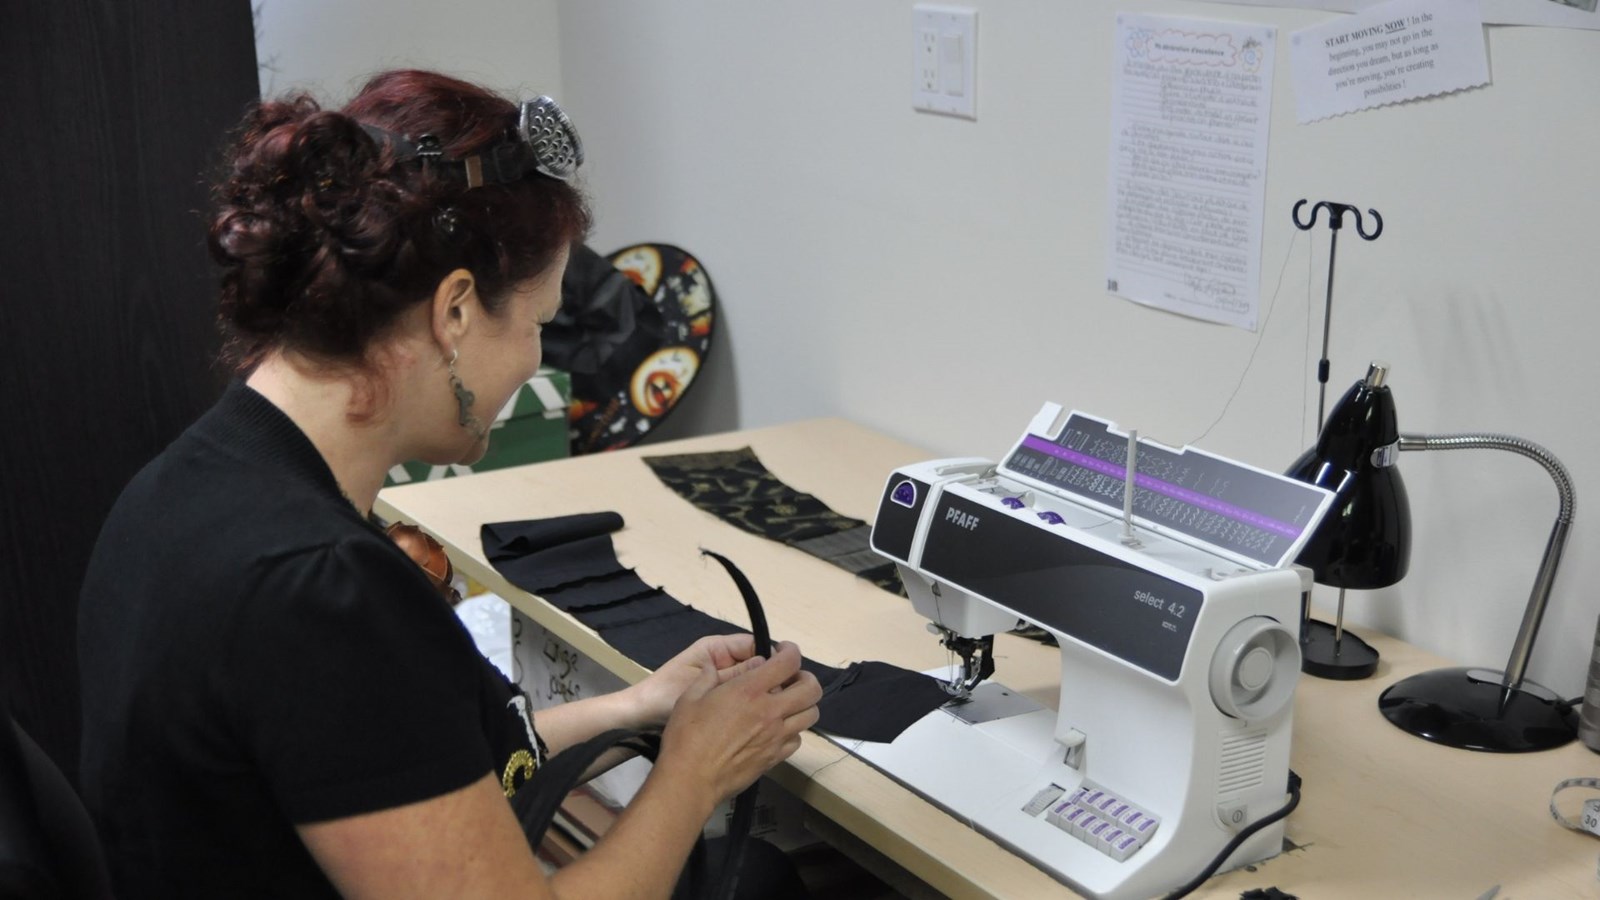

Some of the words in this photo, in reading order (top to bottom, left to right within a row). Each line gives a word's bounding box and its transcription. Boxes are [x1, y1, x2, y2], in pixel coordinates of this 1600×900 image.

[1325, 33, 1349, 47] START
[1351, 25, 1383, 40] MOVING
[1385, 20, 1406, 34] NOW
[1421, 13, 1433, 23] the
[1362, 44, 1374, 55] you
[1375, 41, 1388, 51] may
[1389, 36, 1401, 46] not
[1421, 28, 1432, 38] the
[1328, 63, 1354, 76] direction
[1356, 61, 1368, 72] you
[1369, 54, 1390, 66] dream,
[1392, 51, 1403, 61] but
[1413, 45, 1429, 56] long
[1357, 70, 1383, 83] moving,
[1406, 60, 1434, 73] creating
[1364, 82, 1402, 98] possibilities
[945, 507, 980, 531] PFAFF
[1133, 590, 1164, 610] select
[1168, 602, 1185, 618] 4.2
[1585, 815, 1597, 828] 30
